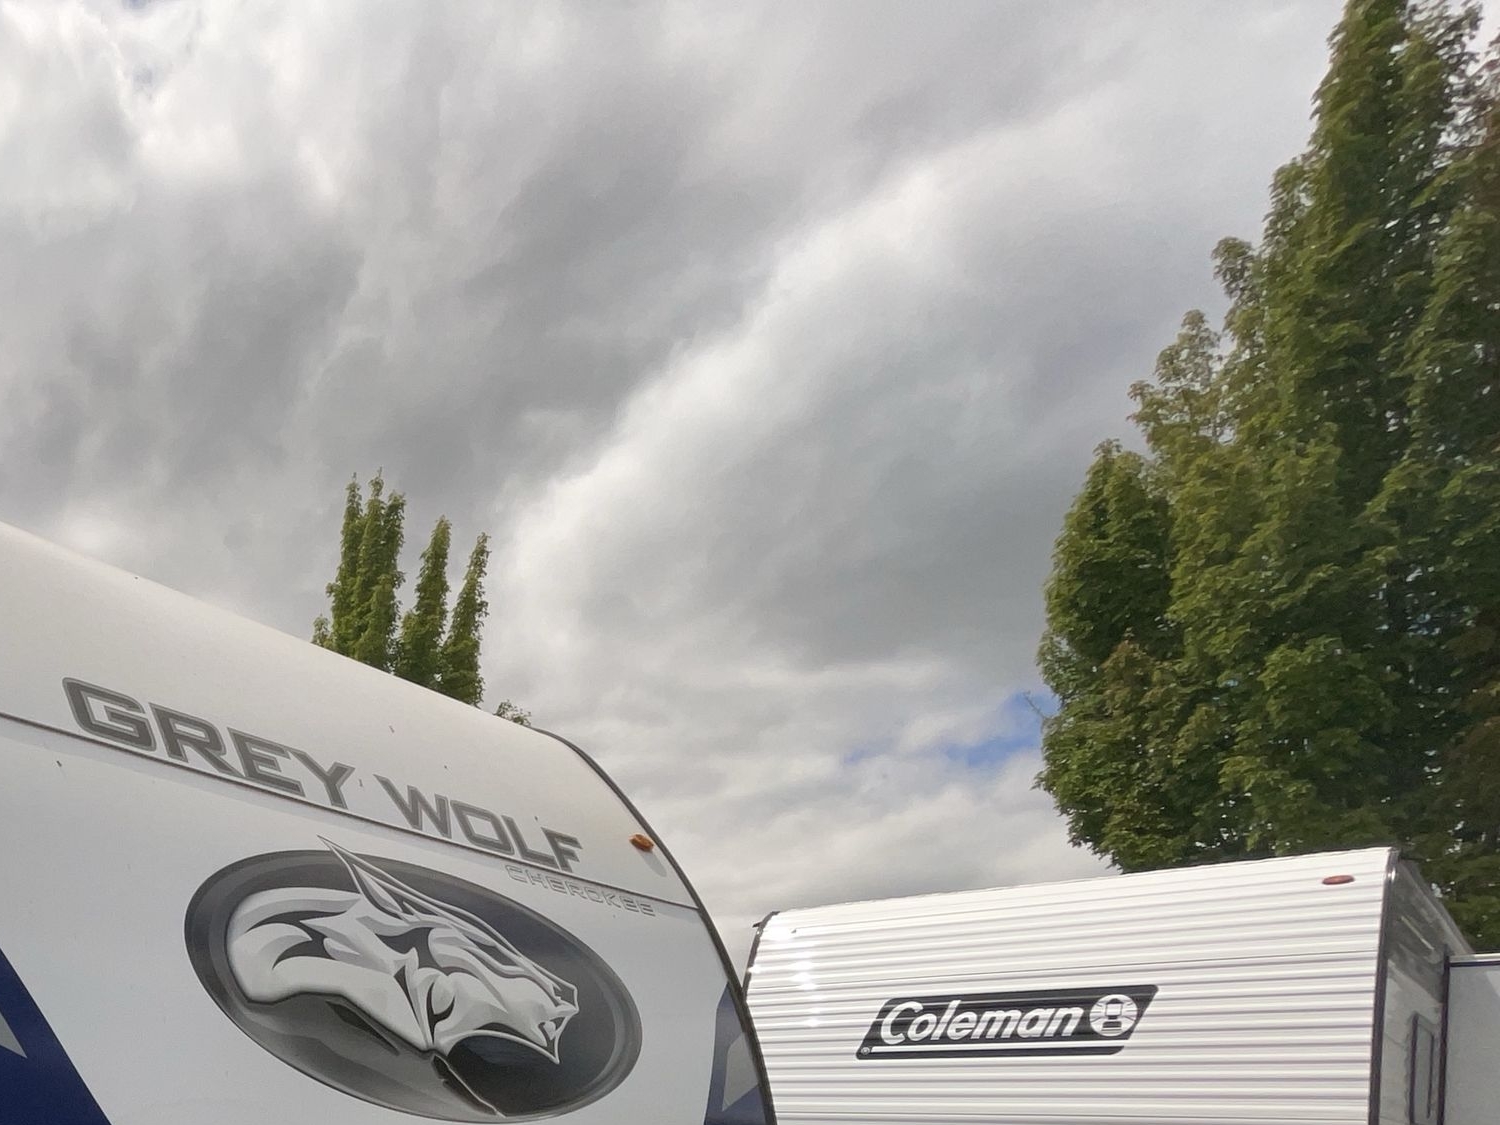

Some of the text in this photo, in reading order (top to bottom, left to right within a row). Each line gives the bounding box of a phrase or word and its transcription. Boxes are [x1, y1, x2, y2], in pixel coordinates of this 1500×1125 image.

[62, 676, 583, 873] GREY WOLF
[505, 864, 656, 917] CHEROKEE
[880, 999, 1085, 1045] Coleman
